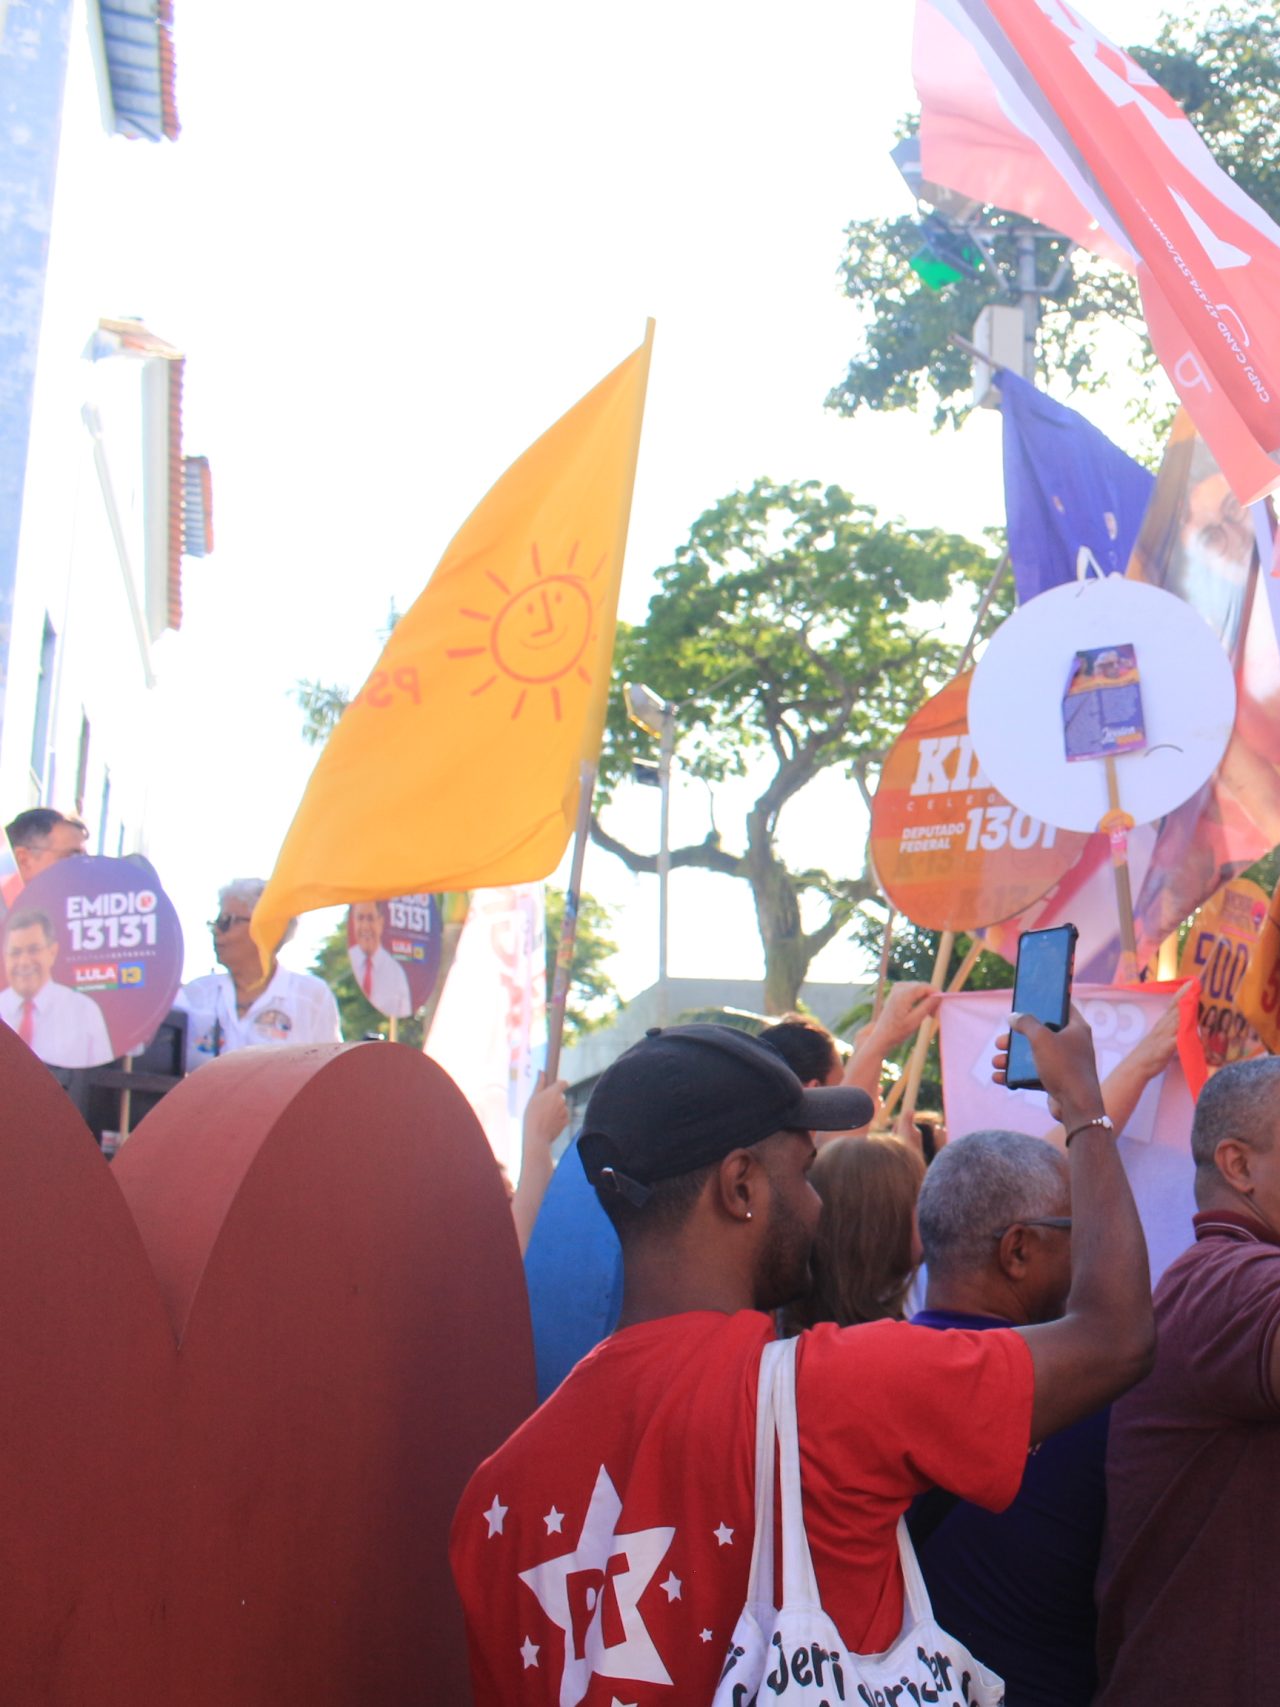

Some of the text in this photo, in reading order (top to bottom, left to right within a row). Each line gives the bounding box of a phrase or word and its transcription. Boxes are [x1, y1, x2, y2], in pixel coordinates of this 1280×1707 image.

[1217, 321, 1247, 364] CAND
[1243, 366, 1271, 403] CNPJ
[900, 838, 951, 854] FEDERAL
[902, 821, 966, 840] DEPUTADO
[66, 889, 158, 919] EMIDIO
[387, 901, 431, 934] 13131
[66, 912, 157, 951] 13131
[75, 966, 143, 985] LULA 13
[566, 1551, 630, 1660] PT
[766, 1630, 845, 1700] Jeri
